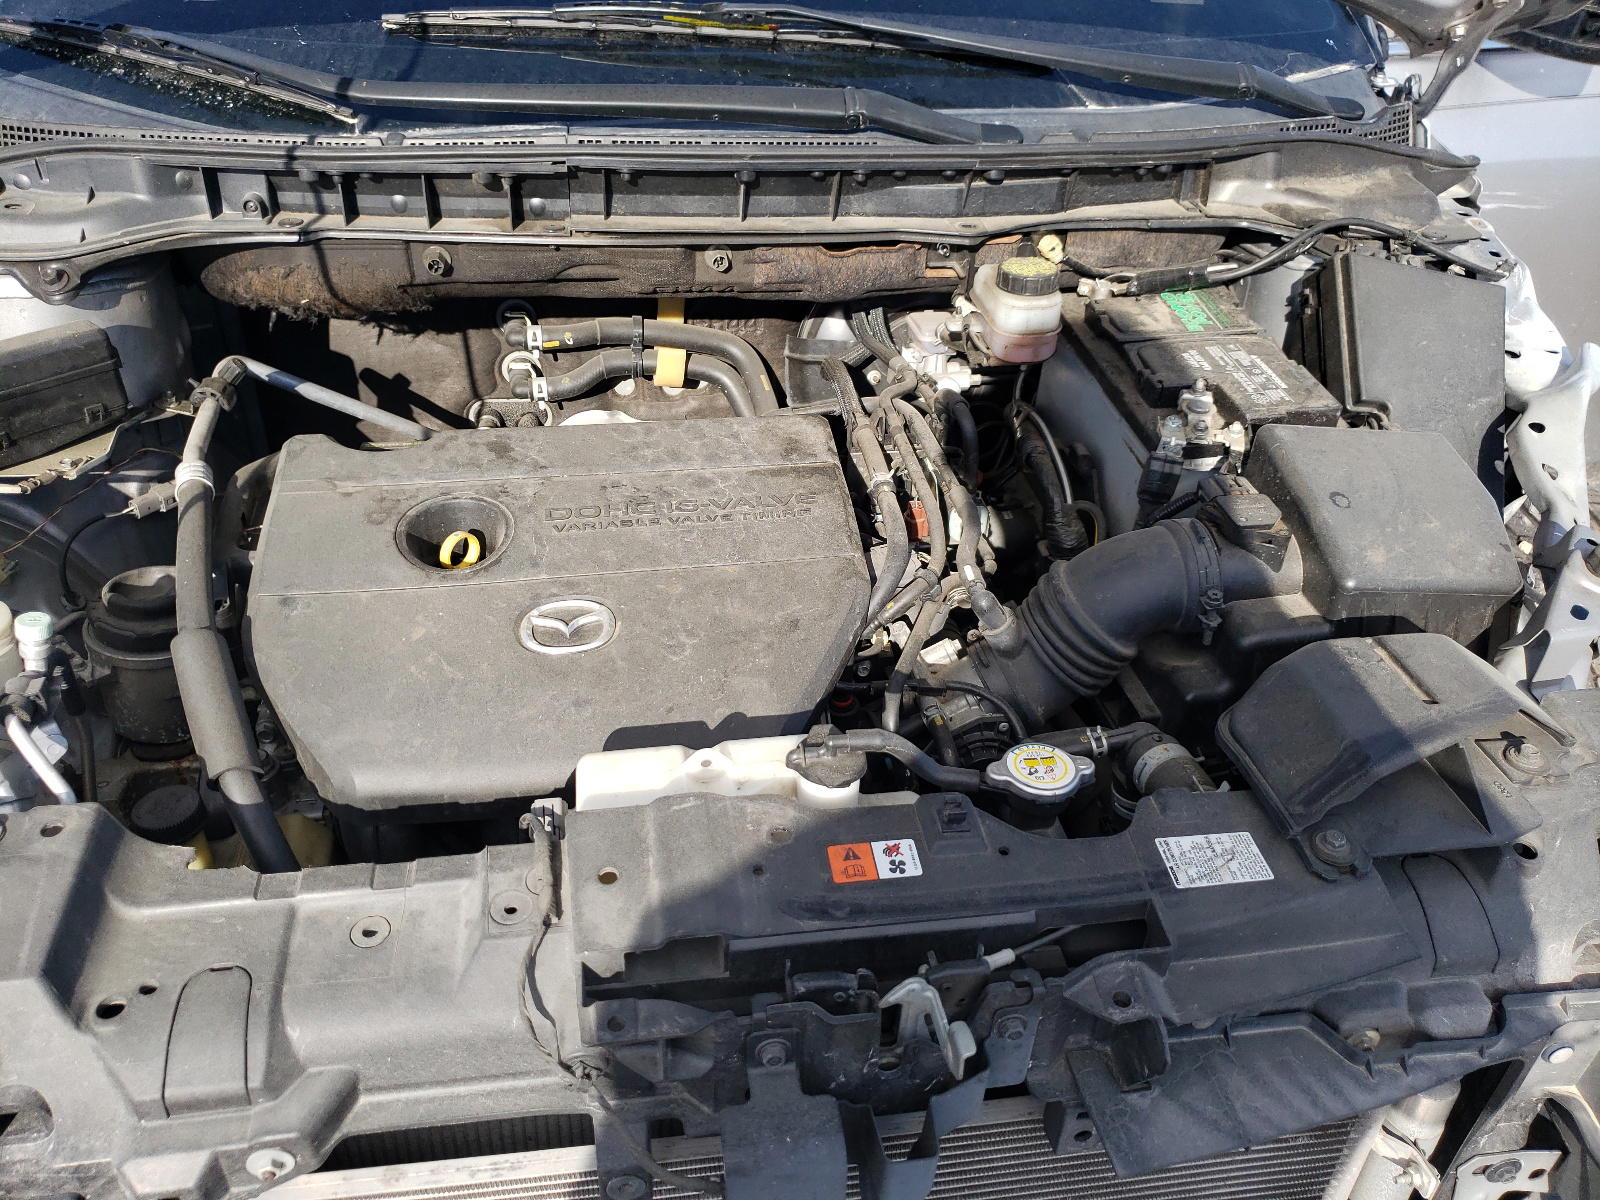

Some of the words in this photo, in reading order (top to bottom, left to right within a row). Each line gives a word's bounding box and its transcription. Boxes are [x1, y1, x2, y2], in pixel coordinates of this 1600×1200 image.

[544, 500, 656, 521] DOHC
[666, 492, 817, 514] 16-VALVE
[551, 517, 661, 534] VARIABLE
[667, 513, 733, 526] VALVE
